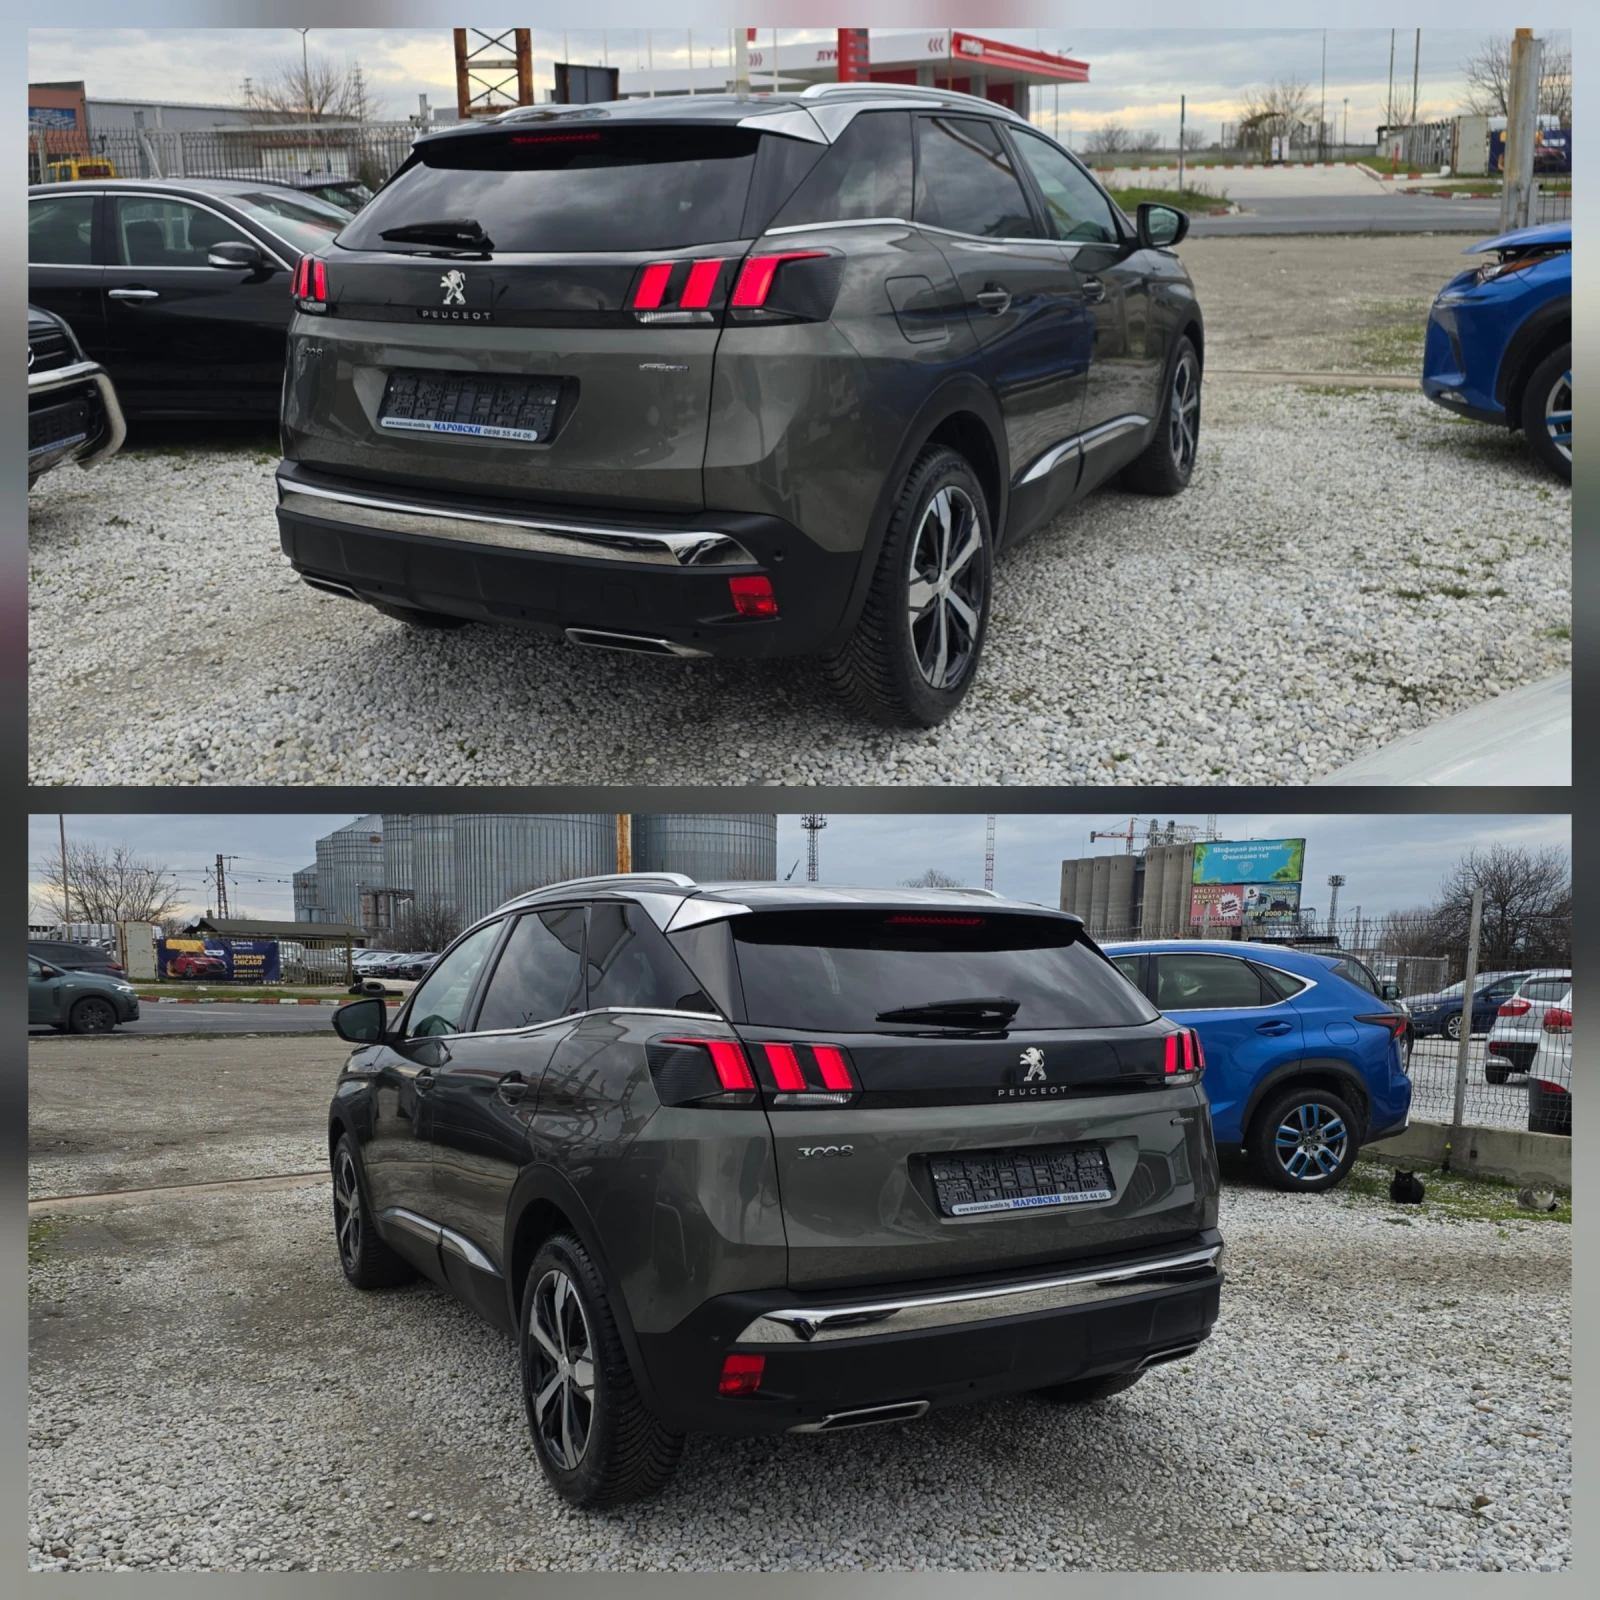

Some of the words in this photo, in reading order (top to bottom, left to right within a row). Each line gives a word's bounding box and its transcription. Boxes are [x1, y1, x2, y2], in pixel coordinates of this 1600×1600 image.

[422, 309, 491, 320] PEUGEOT
[433, 422, 481, 434] МАРОВСКИ
[997, 1085, 1068, 1097] PEUGEOT
[797, 1144, 854, 1160] 3008
[1012, 1195, 1061, 1207] МАРОВСКИ
